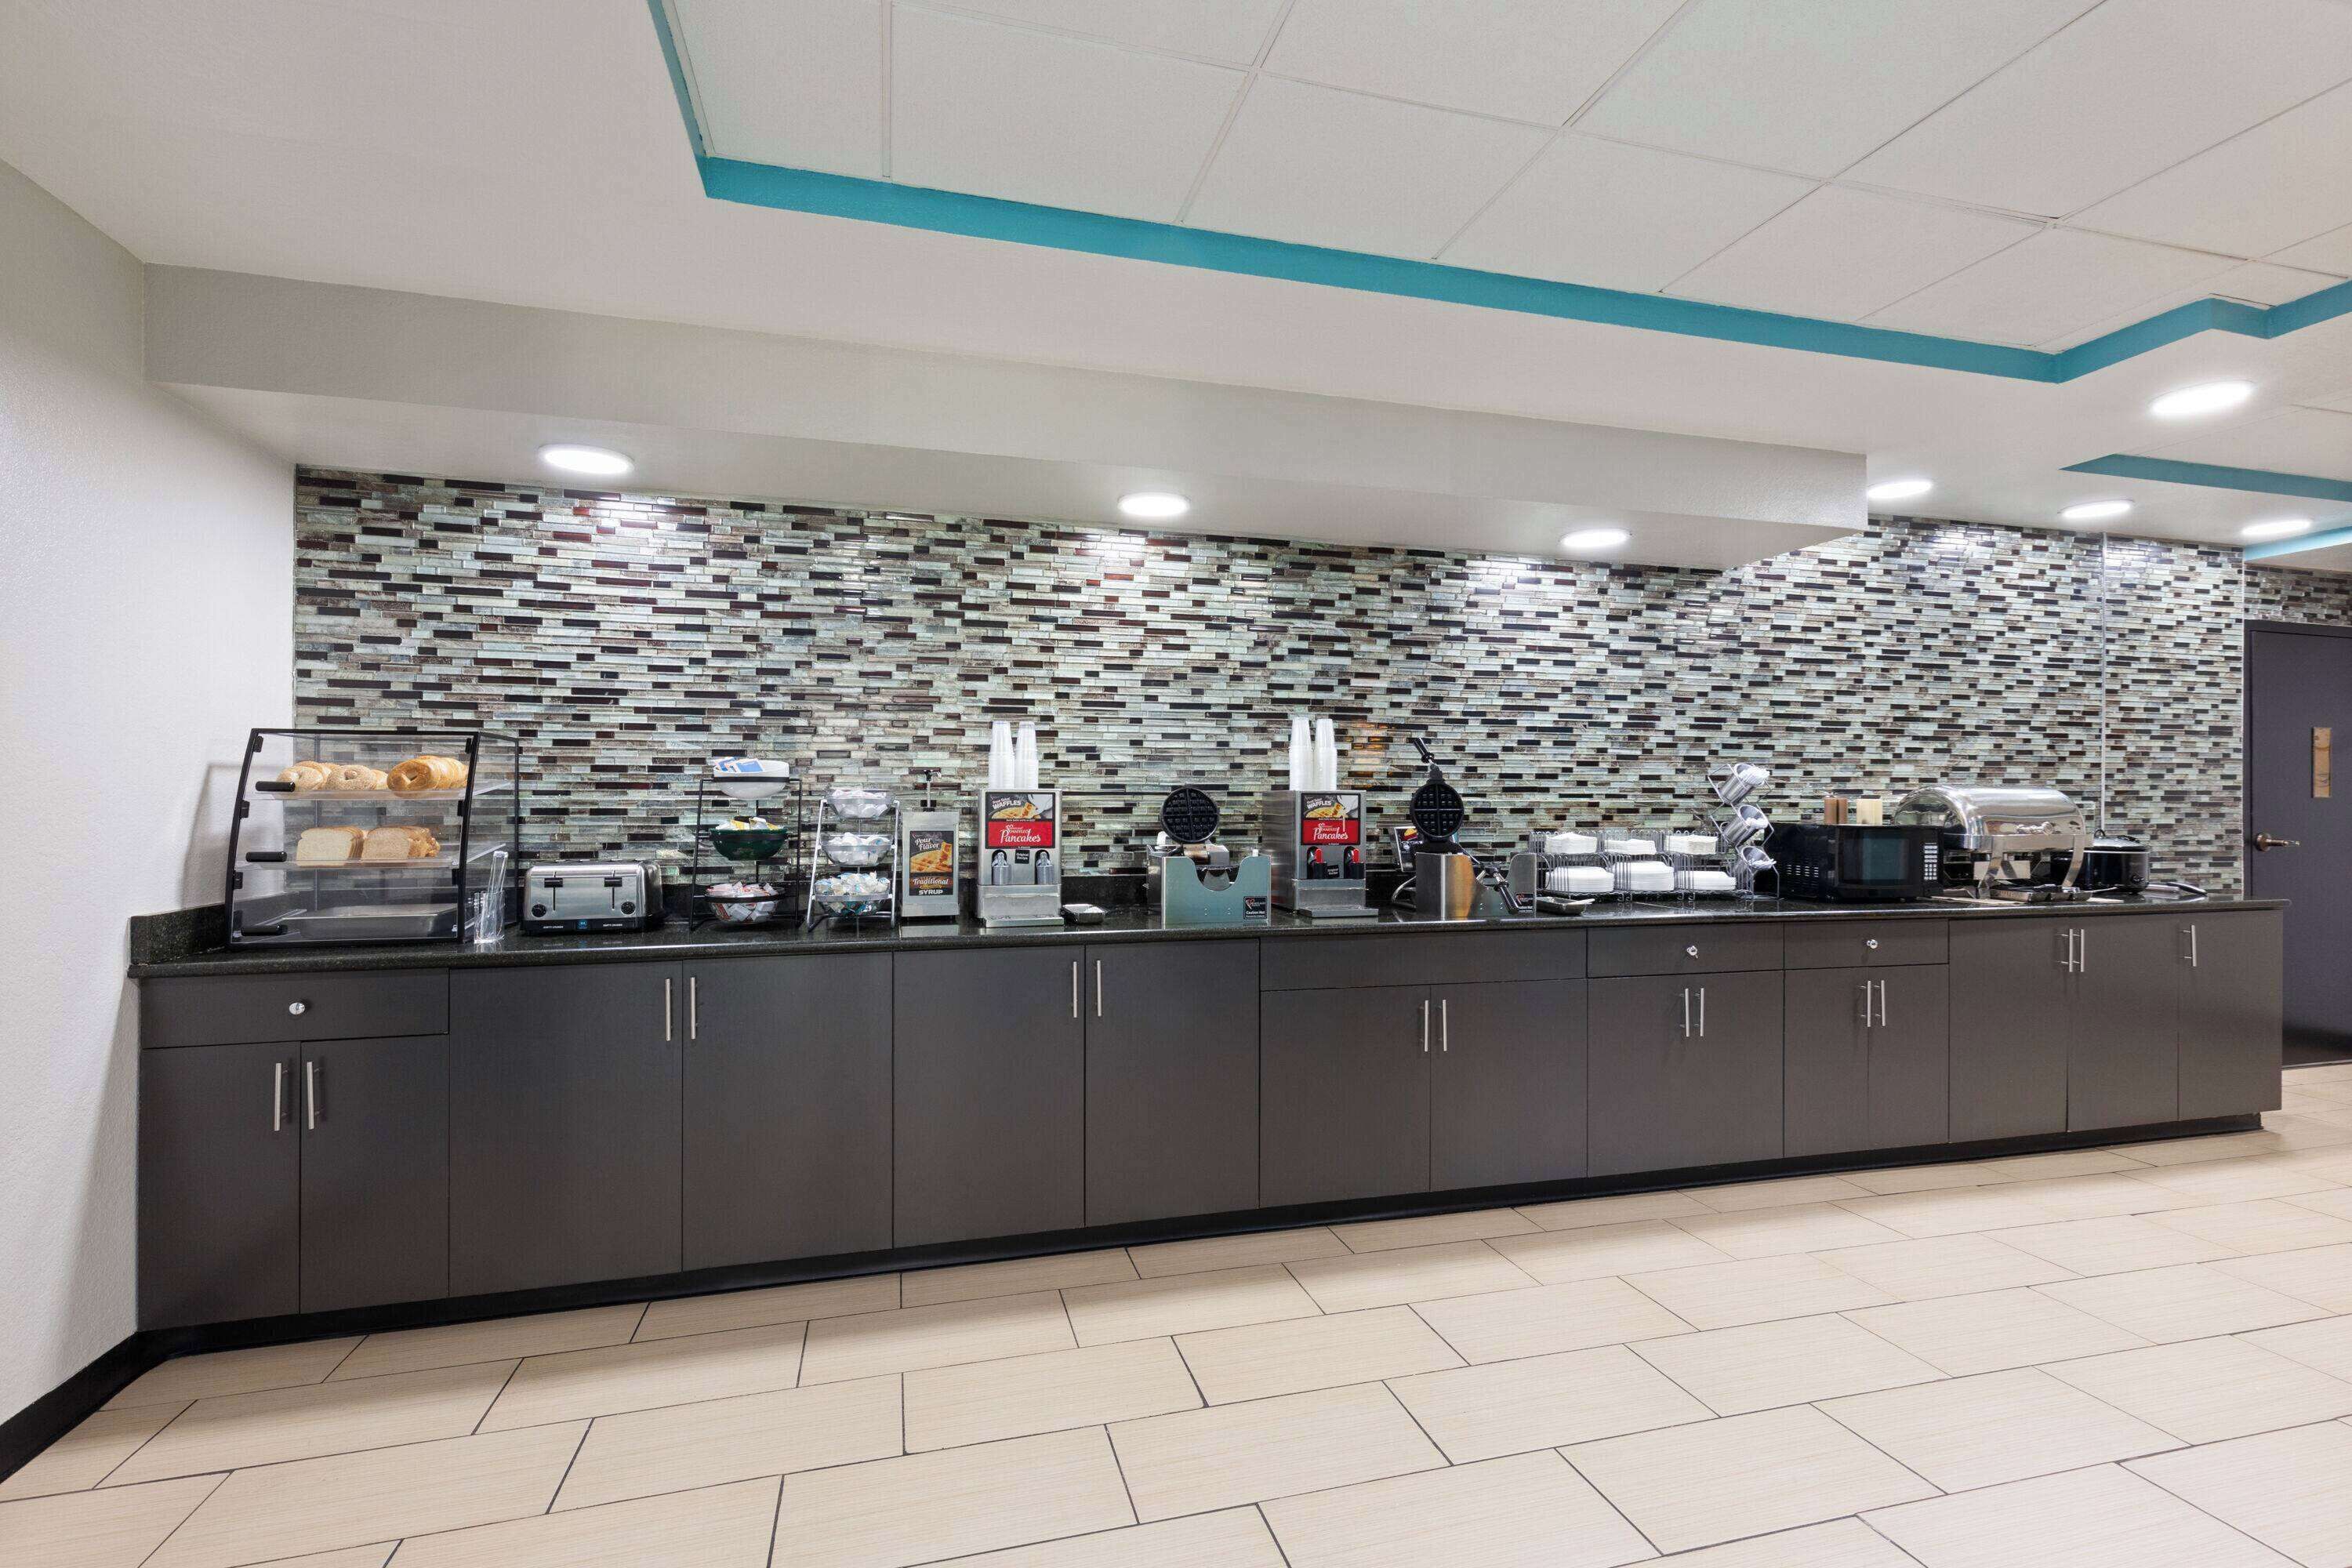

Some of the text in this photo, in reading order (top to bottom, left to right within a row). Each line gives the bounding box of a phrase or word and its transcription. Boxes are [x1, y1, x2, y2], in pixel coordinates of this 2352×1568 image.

[992, 800, 1022, 810] WAFFLES
[1306, 800, 1332, 810] WAFFLES
[999, 828, 1042, 844] Pancakes
[1312, 826, 1349, 841] Pancakes
[918, 843, 940, 851] Flavor
